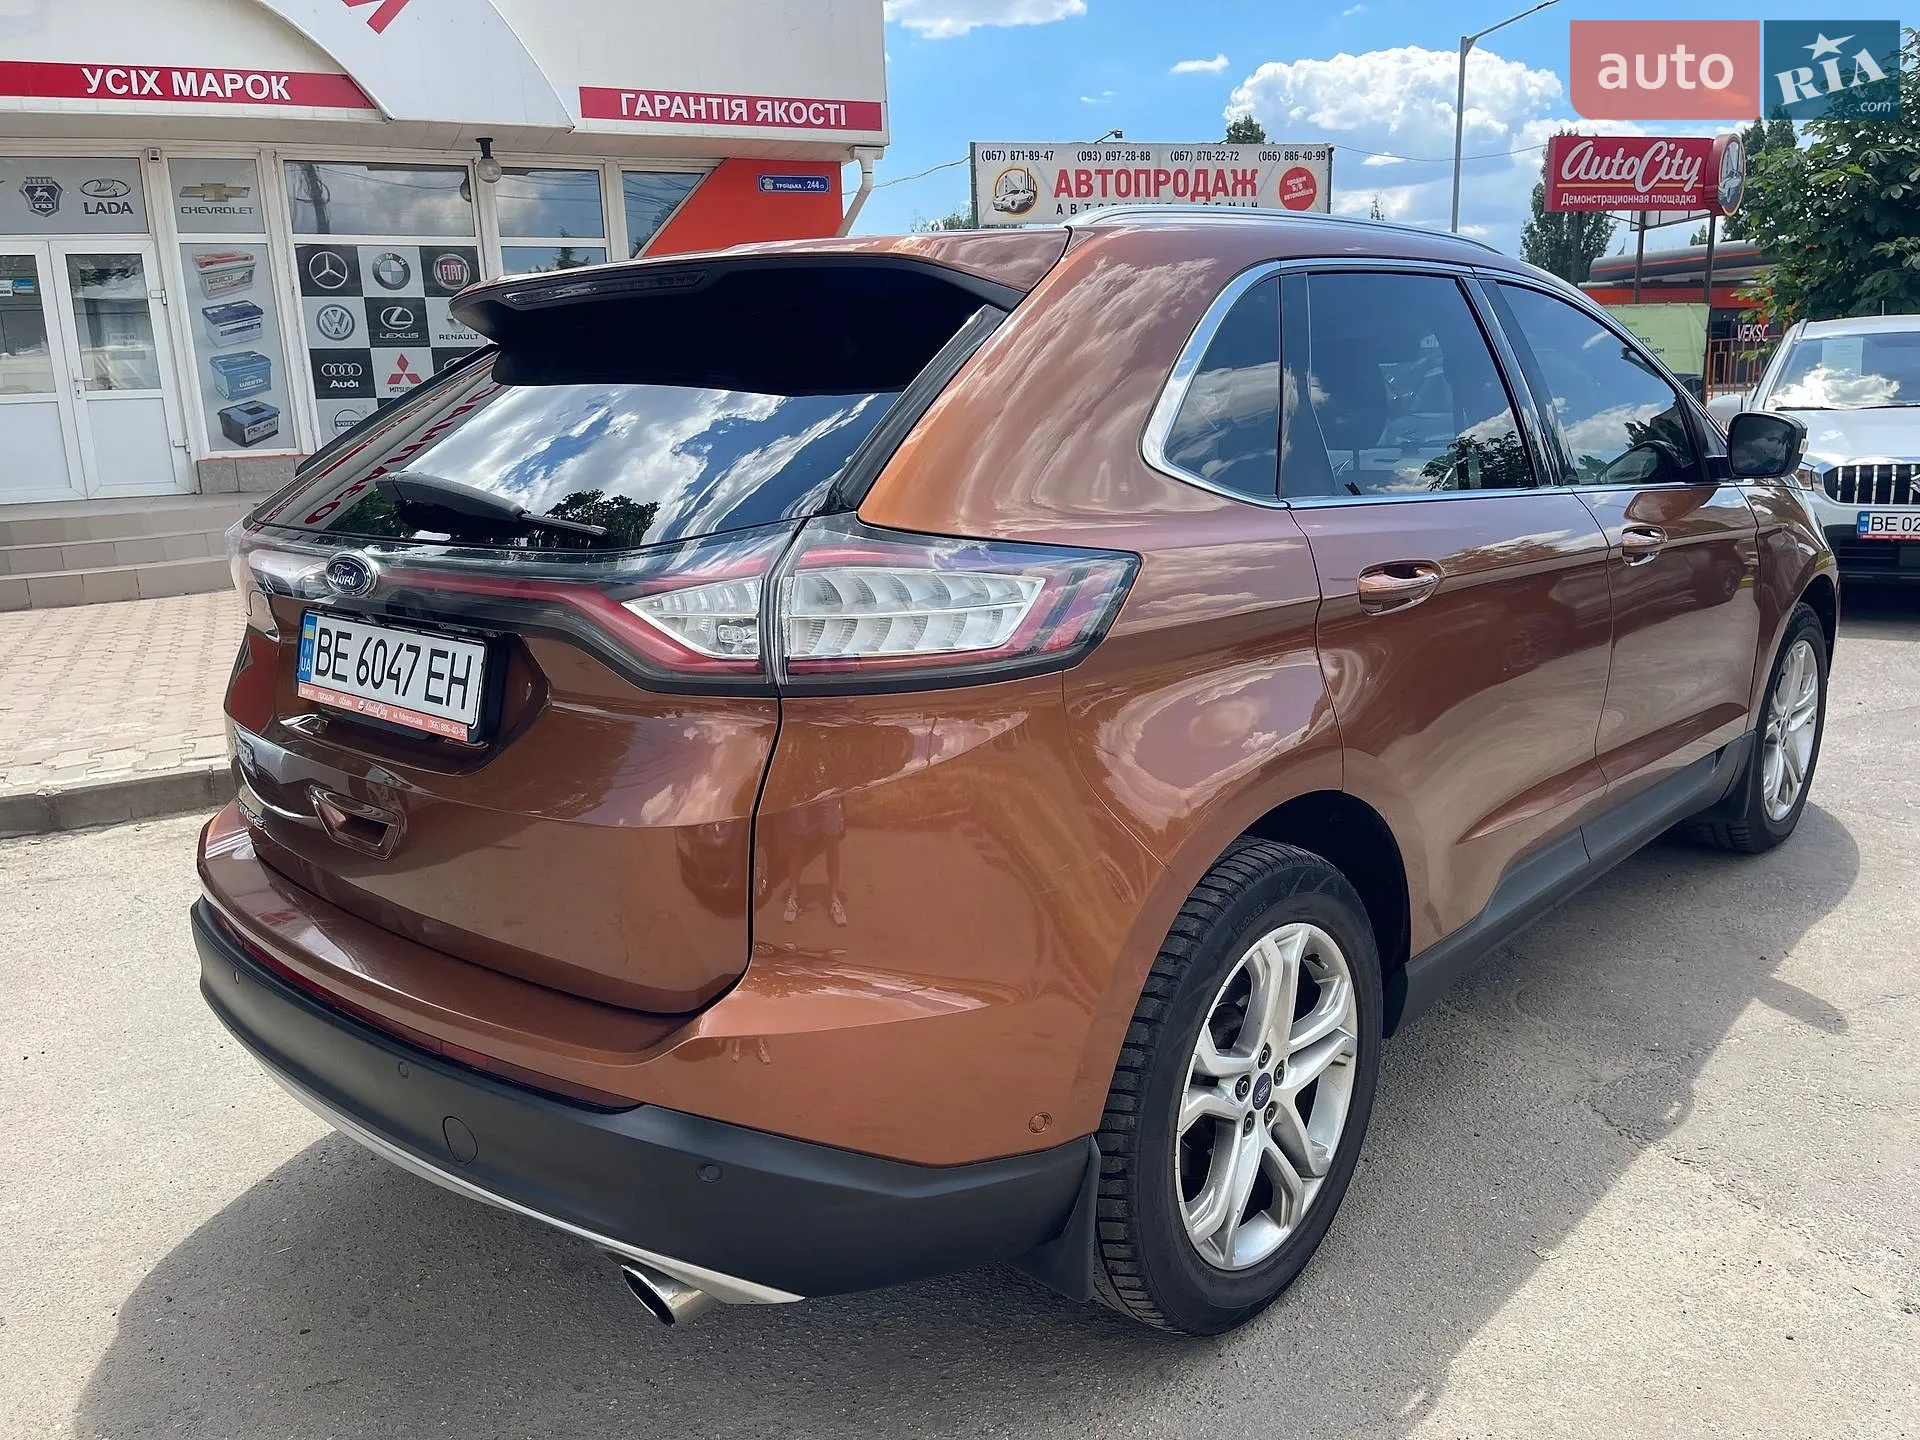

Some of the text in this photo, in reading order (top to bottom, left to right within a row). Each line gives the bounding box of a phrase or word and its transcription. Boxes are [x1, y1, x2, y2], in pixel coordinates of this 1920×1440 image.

[81, 68, 291, 100] УСІХ МАРОК
[620, 93, 846, 126] ГАРАНТІЯ ЯКОСТІ
[981, 150, 1054, 162] (067) 871-89-47
[1077, 150, 1151, 162] (093) 097-28-88
[1170, 151, 1239, 162] (067) 870-22-72
[1258, 151, 1326, 162] (066) 886-40-99
[1561, 140, 1702, 192] AutoCity
[1054, 168, 1258, 202] АВТОПРОДАЖ
[1561, 192, 1696, 206] Демонстрационная площадка
[83, 202, 134, 215] LADA
[181, 206, 255, 215] CHEVROLET
[441, 264, 462, 280] FIAT
[329, 379, 359, 389] Audi
[1871, 516, 1898, 532] BE
[332, 563, 357, 587] Ford
[300, 655, 311, 673] UA
[315, 627, 472, 709] BE 6047 EH
